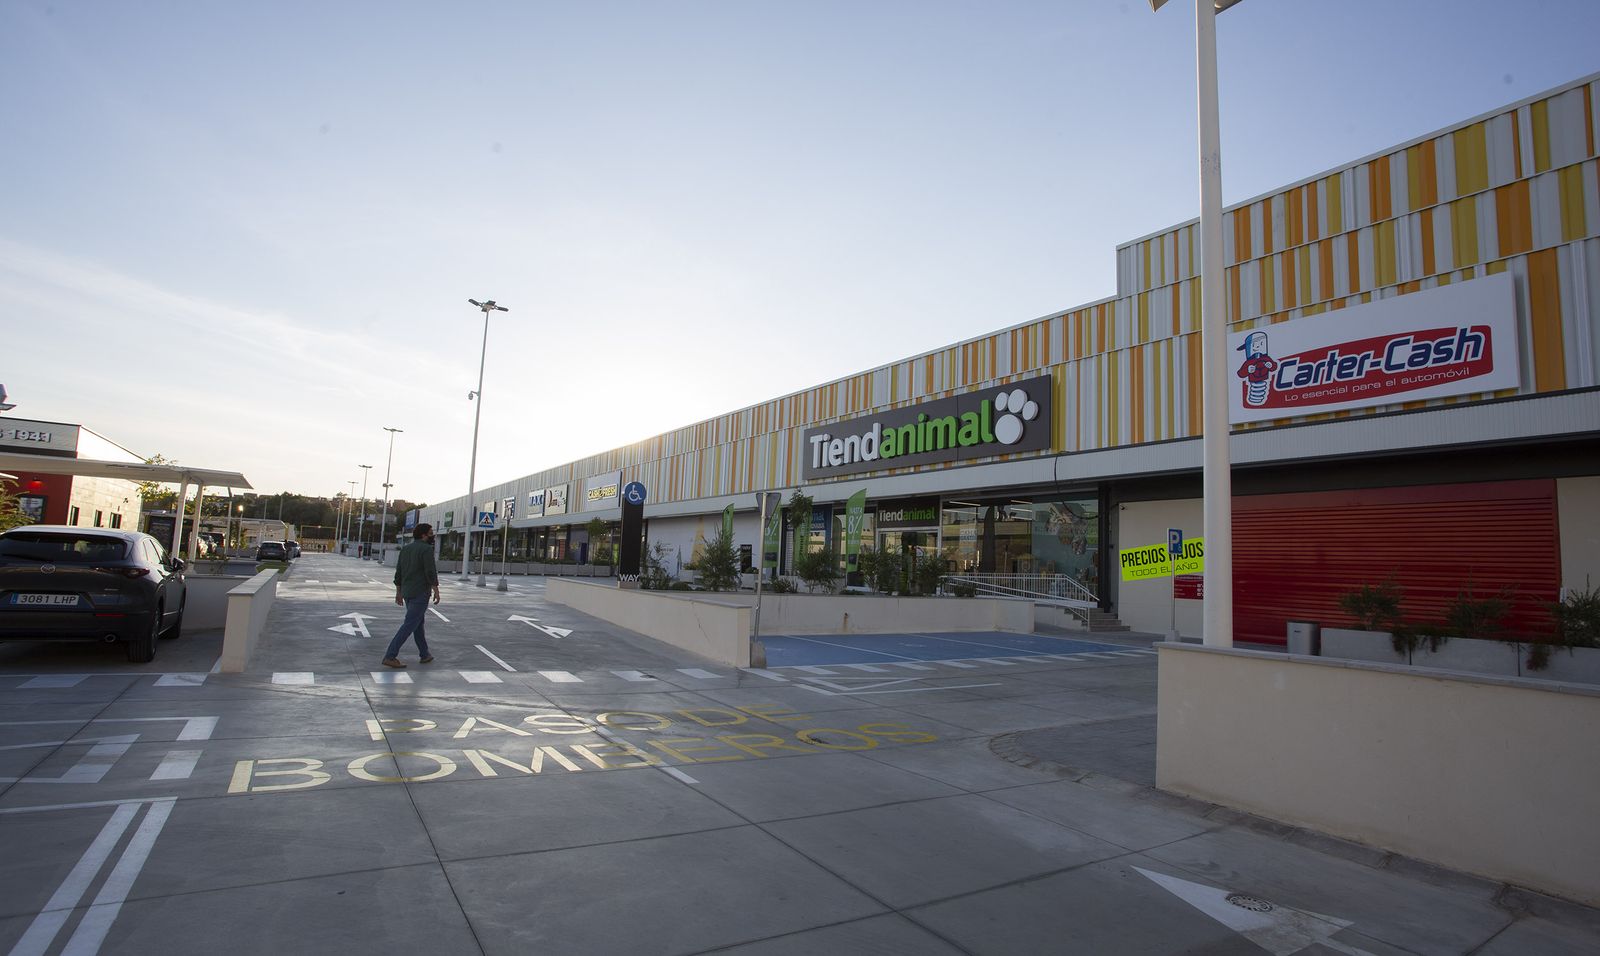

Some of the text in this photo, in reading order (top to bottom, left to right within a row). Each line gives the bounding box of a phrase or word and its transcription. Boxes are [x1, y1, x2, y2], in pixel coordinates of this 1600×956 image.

[1274, 326, 1483, 389] Carter-Cash
[1285, 367, 1470, 402] Lo esencial para el automóvil
[809, 399, 994, 469] Tiendanimal
[879, 507, 935, 522] Tiendanimal
[1169, 530, 1180, 552] P
[1121, 547, 1166, 568] PRECIOS
[619, 573, 640, 582] WAY
[1160, 566, 1172, 574] EL
[20, 595, 77, 604] 3081 LHP
[364, 703, 812, 741] PASO DE
[227, 722, 938, 794] BOMBEROS
